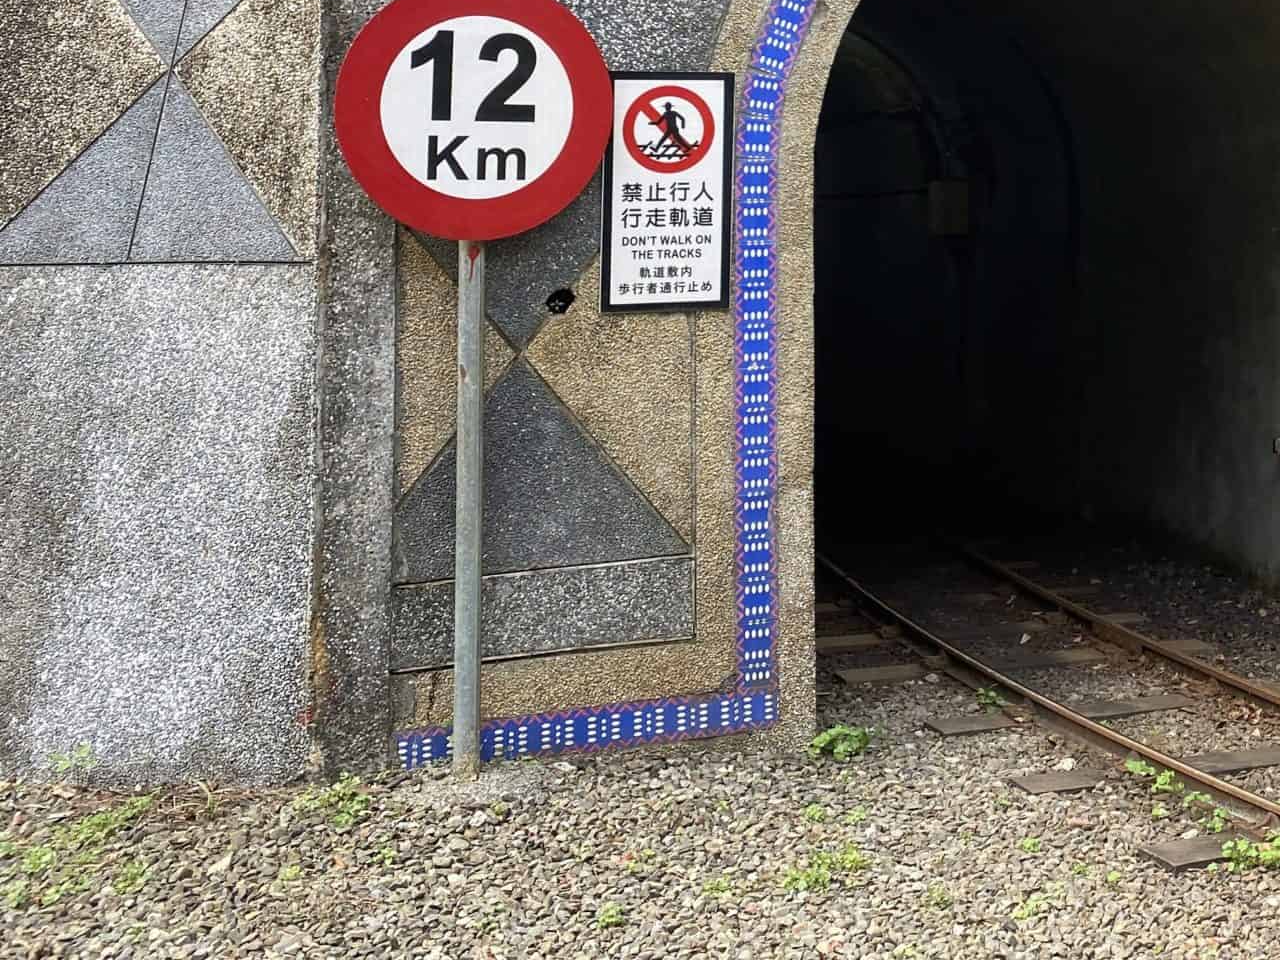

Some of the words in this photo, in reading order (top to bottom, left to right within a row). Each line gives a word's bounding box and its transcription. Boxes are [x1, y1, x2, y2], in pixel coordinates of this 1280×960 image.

[410, 30, 537, 123] 12
[427, 135, 526, 180] Km
[621, 181, 714, 203] 禁止行人
[621, 207, 714, 229] 行走軌道
[621, 236, 657, 247] DON'T
[660, 235, 692, 245] WALK
[695, 234, 712, 245] ON
[631, 250, 654, 260] THE
[657, 248, 702, 259] TRACKS
